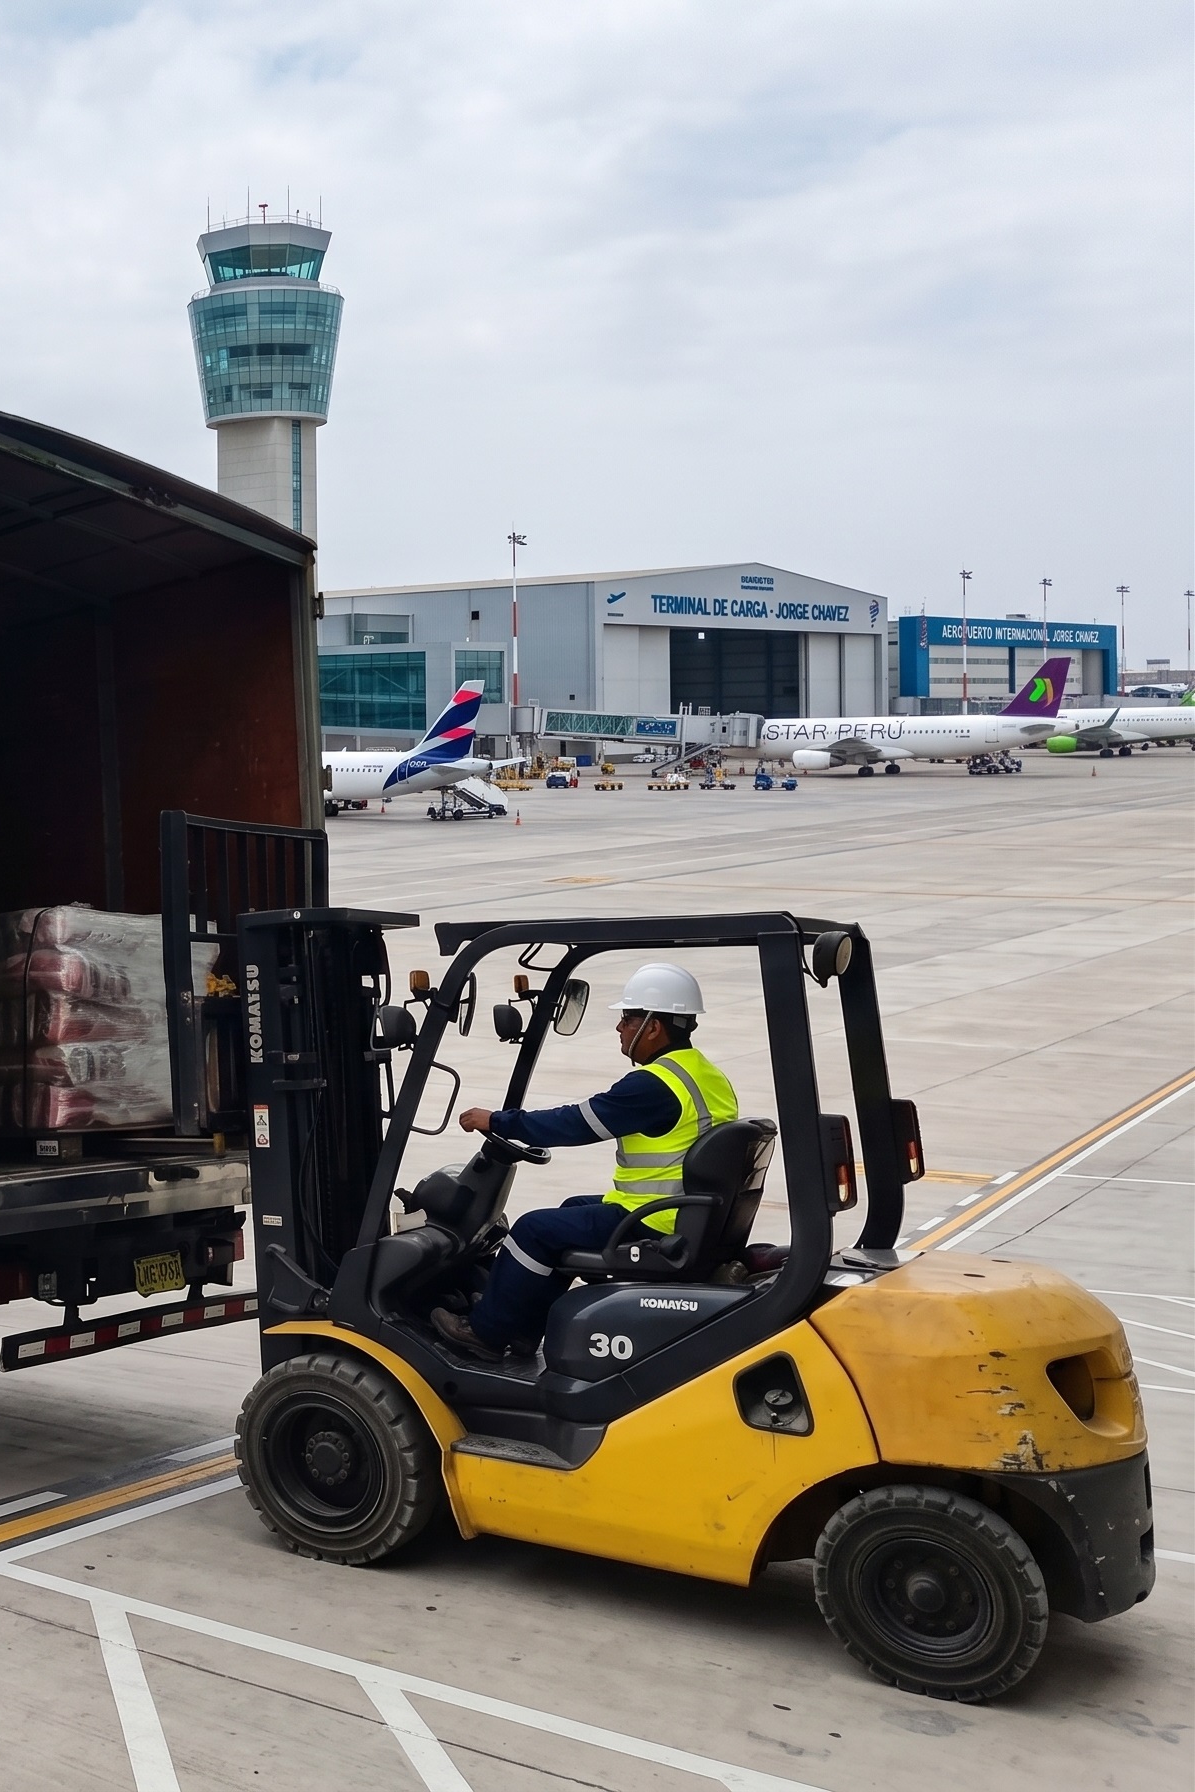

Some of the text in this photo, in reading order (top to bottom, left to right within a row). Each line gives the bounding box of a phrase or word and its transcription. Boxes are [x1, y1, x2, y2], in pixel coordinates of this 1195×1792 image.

[651, 594, 850, 622] TERMINAL DE CARGA JORGE CHAVEZ
[766, 724, 827, 741] STAR
[588, 1332, 634, 1360] 30
